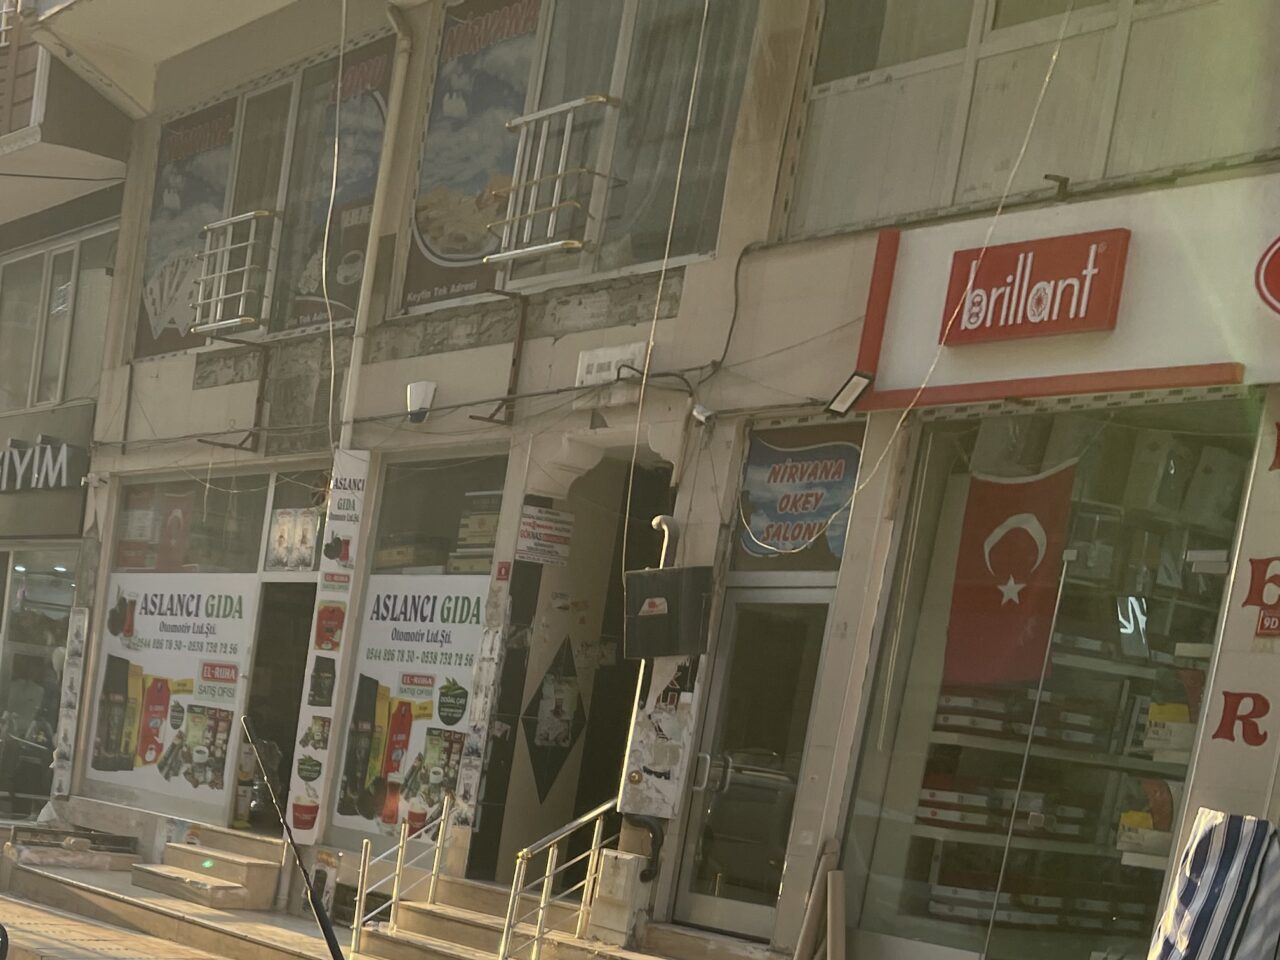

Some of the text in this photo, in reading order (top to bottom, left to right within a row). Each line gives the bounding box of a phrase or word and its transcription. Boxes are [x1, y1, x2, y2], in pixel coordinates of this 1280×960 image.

[434, 286, 448, 296] Tek
[449, 279, 478, 293] Adresi
[960, 244, 1099, 330] brillant
[767, 458, 846, 484] NİRVANA
[333, 478, 366, 492] ASLANCI
[337, 498, 356, 511] GIDA
[777, 491, 825, 514] OKEY
[139, 593, 244, 619] ASLANCI GIDA
[370, 593, 481, 625] ASLANCI GIDA
[159, 620, 191, 634] Otomotiv
[391, 627, 425, 643] Otomotiv
[366, 647, 381, 660] 0544
[382, 648, 395, 661] 826
[397, 650, 405, 662] 78
[405, 650, 416, 663] 30
[420, 650, 438, 664] 0538
[453, 653, 463, 667] 72
[464, 654, 474, 667] 56
[198, 685, 216, 698] SATIŞ
